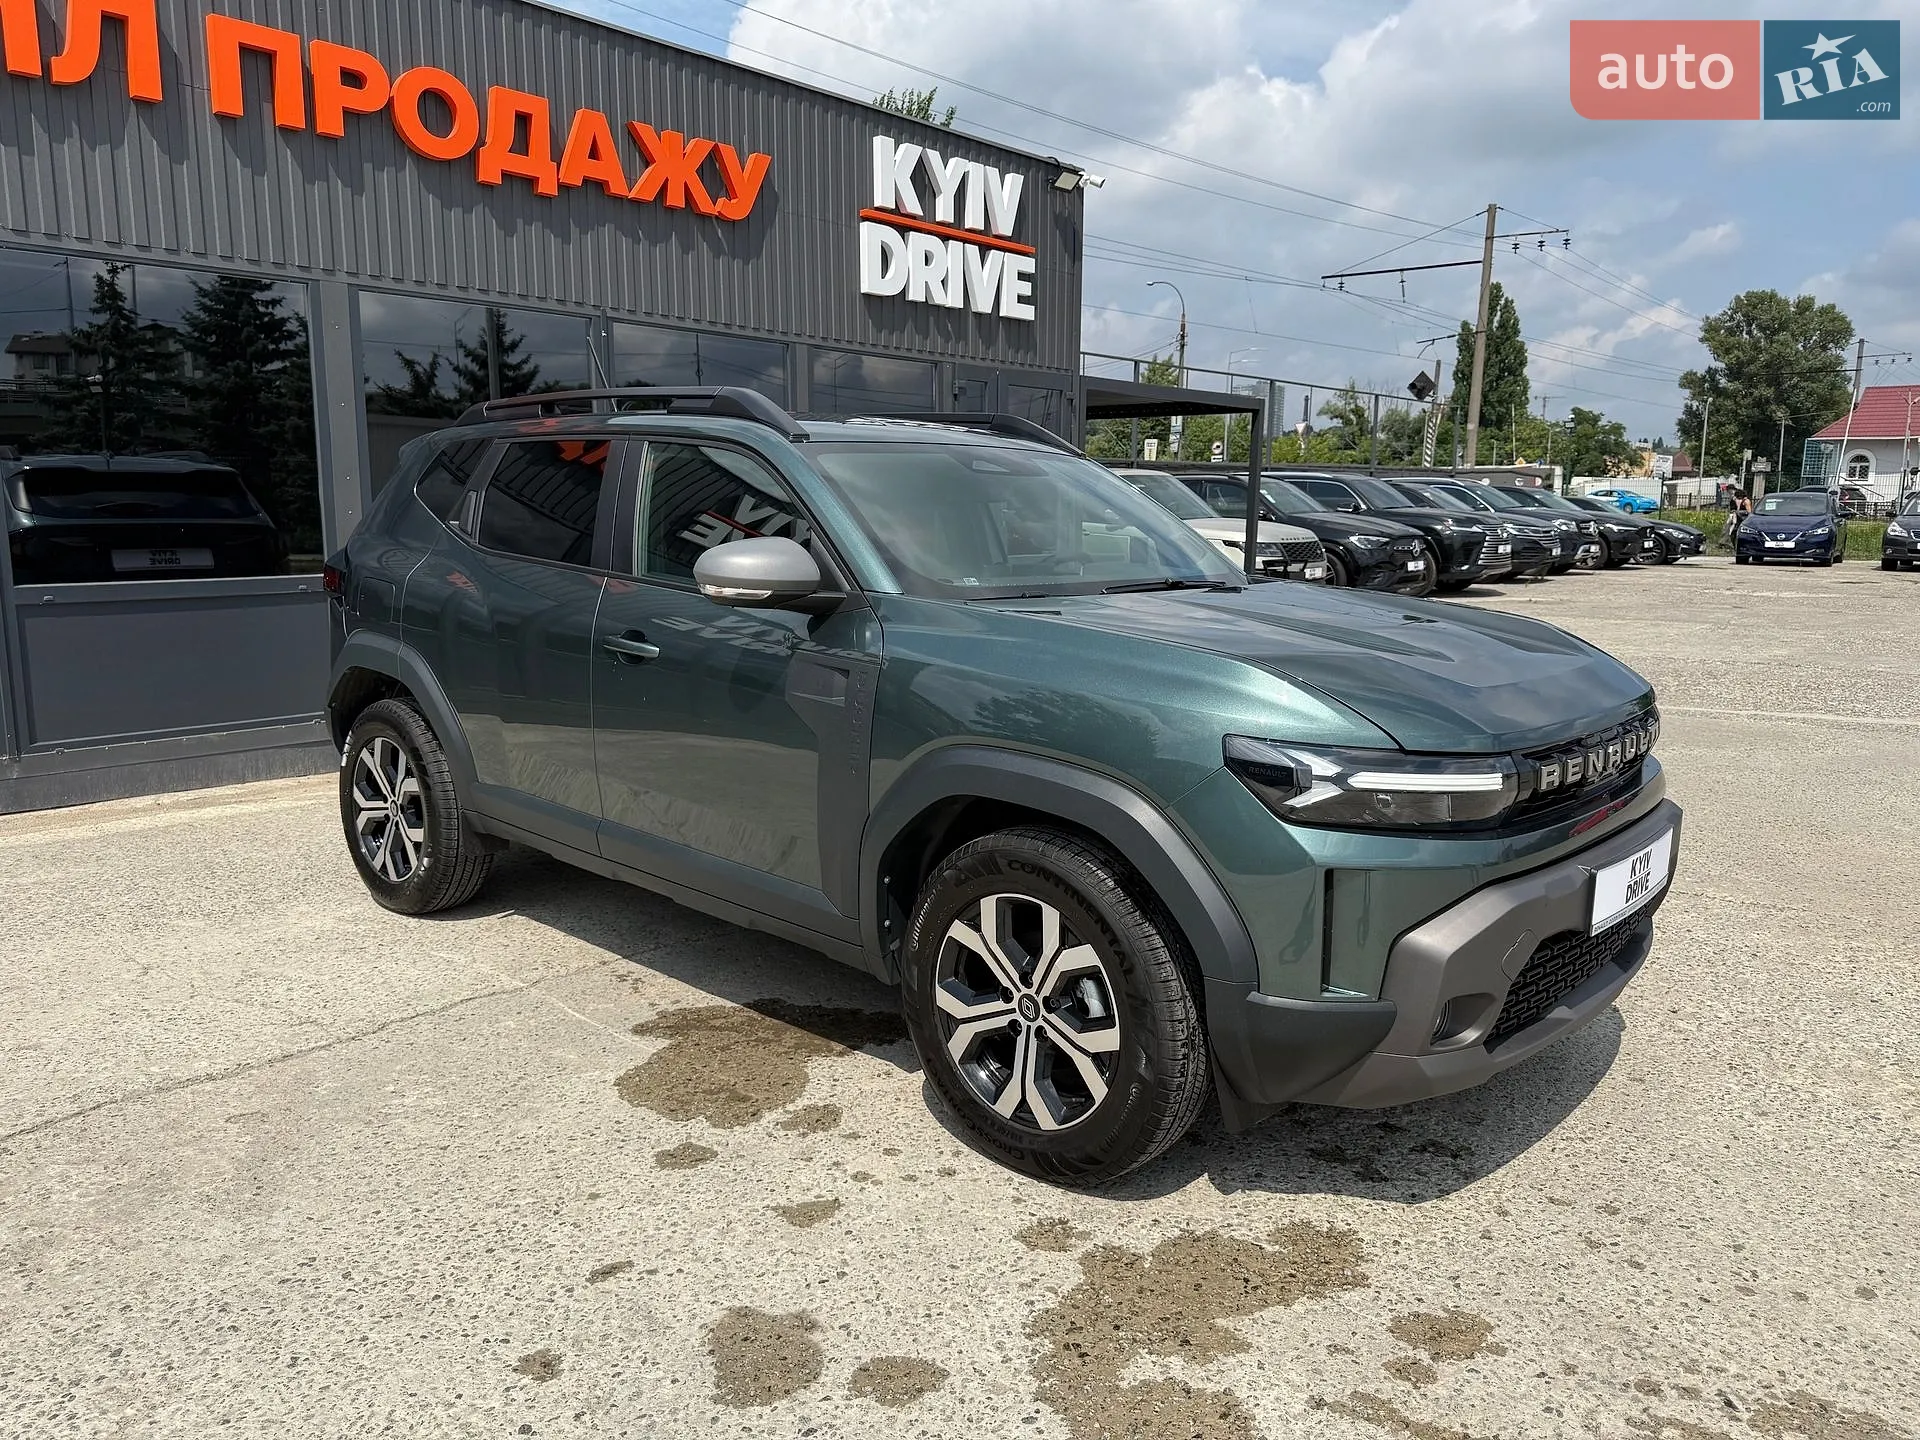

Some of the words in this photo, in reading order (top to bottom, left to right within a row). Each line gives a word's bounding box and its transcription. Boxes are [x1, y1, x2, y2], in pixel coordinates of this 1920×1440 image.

[206, 14, 771, 221] ПРОДАЖУ
[873, 135, 1024, 237] KYIV
[860, 221, 1036, 321] DRIVE
[1624, 871, 1652, 905] DRIVE
[1630, 848, 1653, 879] KYIV
[1007, 859, 1135, 985] CONTINENTAL
